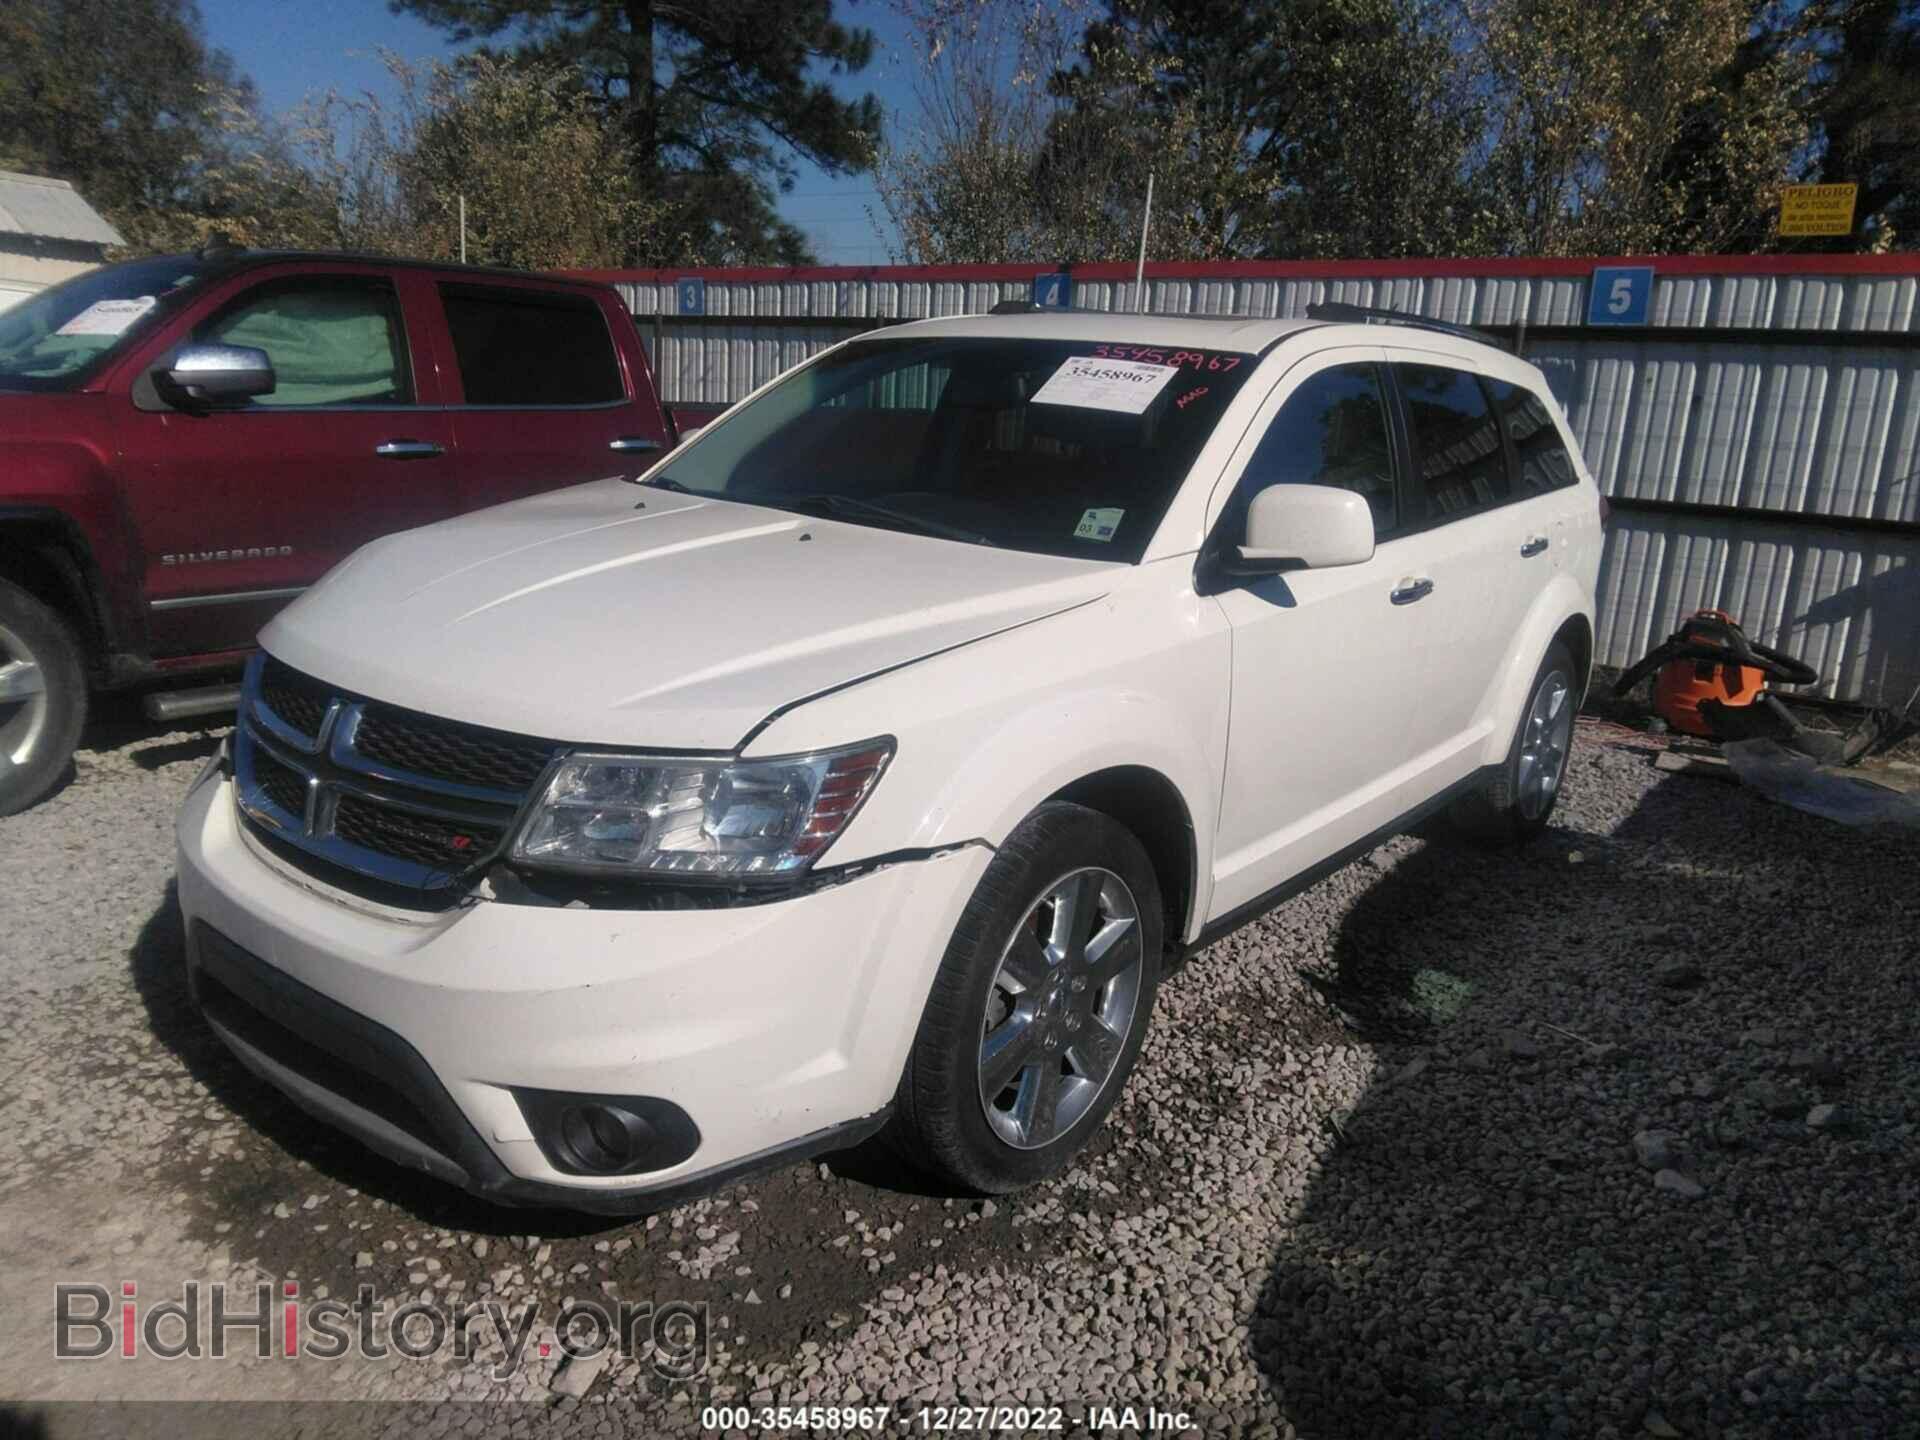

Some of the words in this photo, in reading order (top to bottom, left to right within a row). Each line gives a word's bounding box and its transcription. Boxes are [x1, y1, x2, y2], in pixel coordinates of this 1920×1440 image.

[1788, 187, 1854, 199] PELIGRO
[686, 285, 696, 309] 3
[1045, 282, 1060, 306] 4
[1608, 278, 1632, 315] 5
[1091, 345, 1241, 372] 35458967
[1066, 366, 1157, 385] 35458967
[161, 545, 292, 565] SILVERADO
